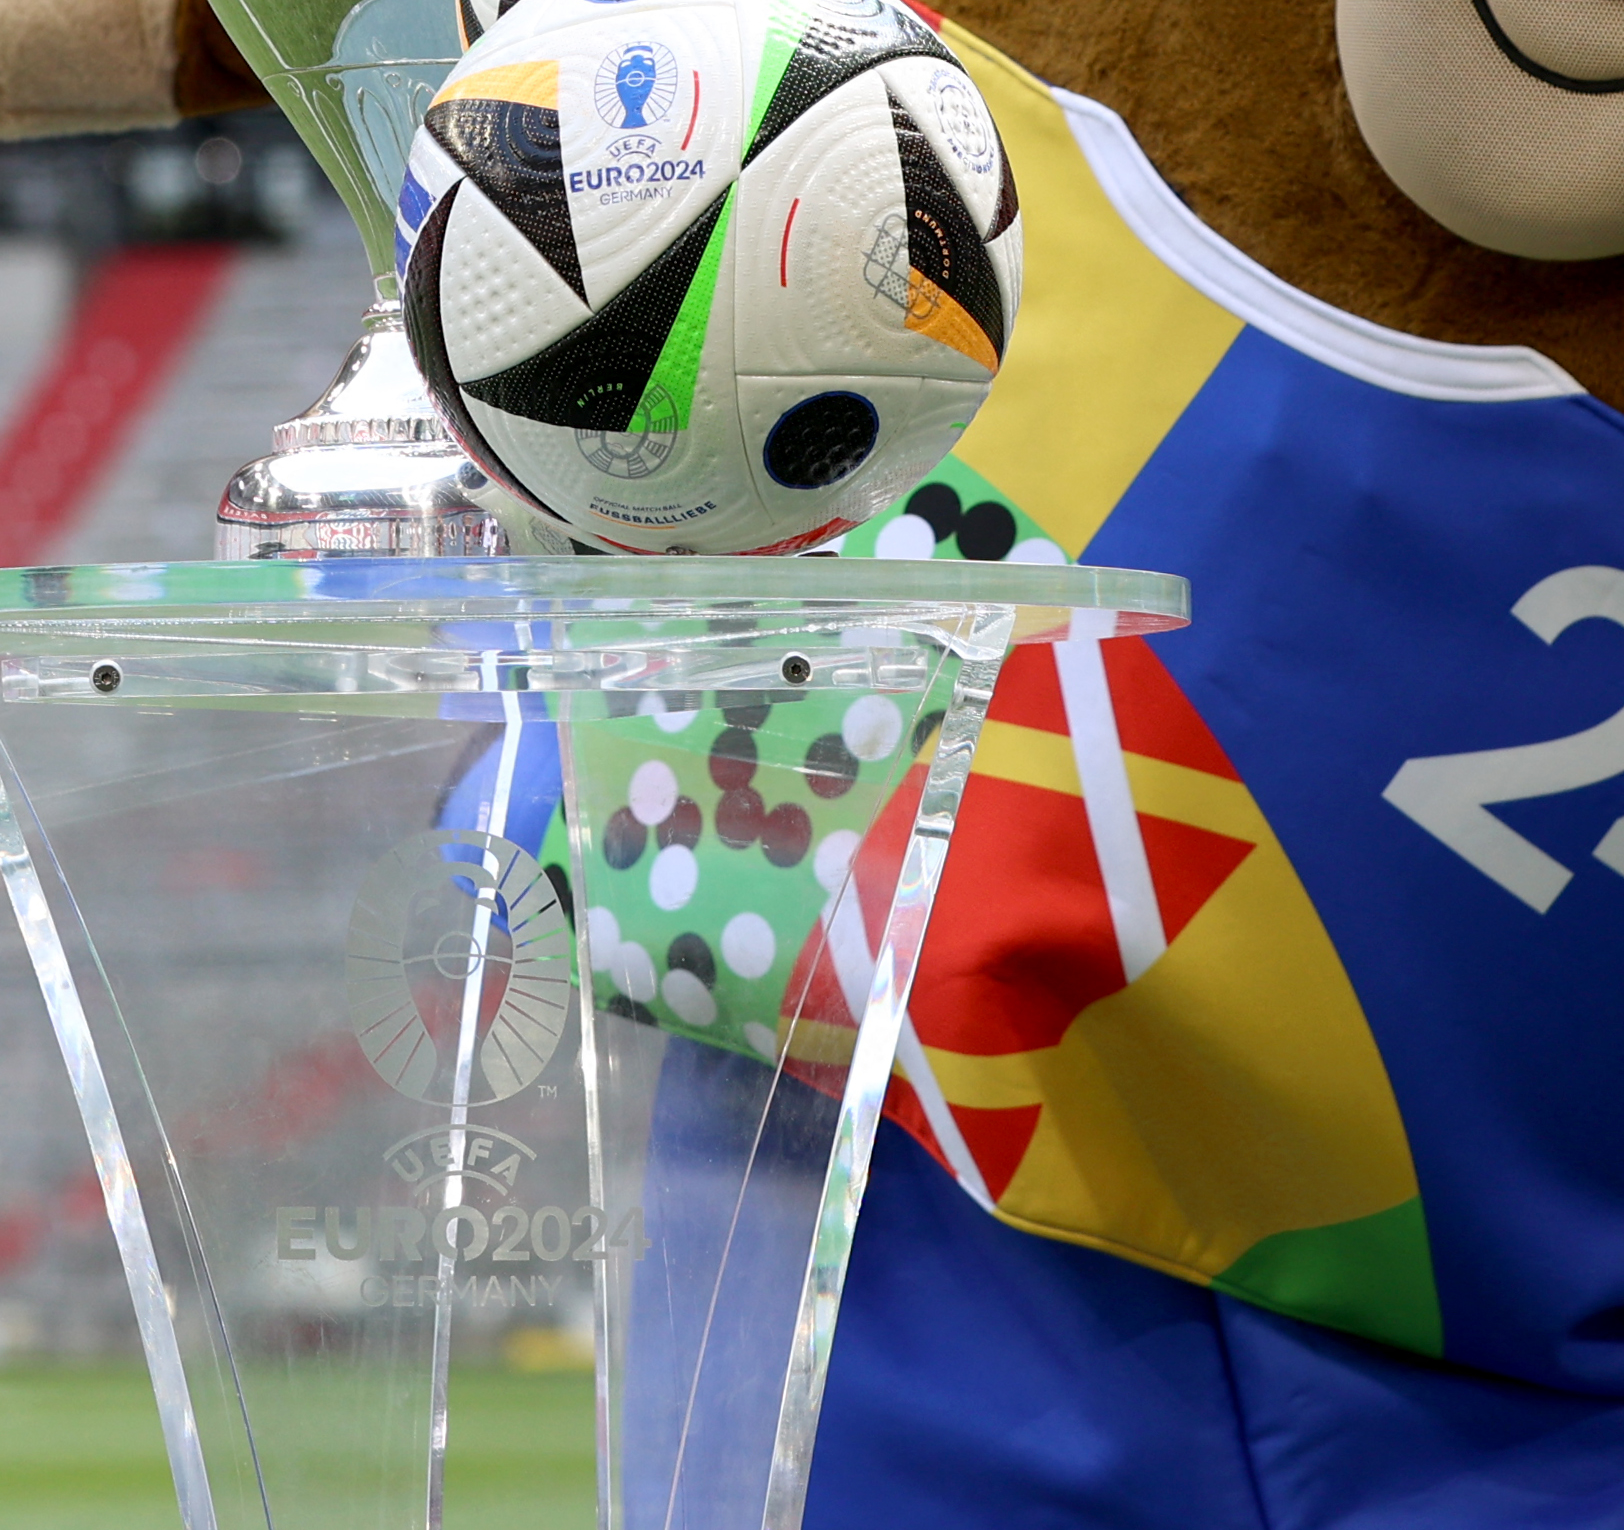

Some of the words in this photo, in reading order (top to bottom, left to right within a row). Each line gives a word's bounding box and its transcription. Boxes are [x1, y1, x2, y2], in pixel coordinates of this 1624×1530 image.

[609, 138, 657, 159] UEFA
[569, 159, 706, 193] EURO2024
[599, 186, 674, 206] GERMANY
[914, 210, 951, 280] DORTMUND
[576, 382, 624, 409] BERLIN
[589, 500, 718, 525] FUSSBALLLIEBE
[592, 496, 630, 511] OFFICIAL
[662, 503, 683, 512] BALL
[391, 1136, 522, 1187] UEFA
[276, 1205, 653, 1262] EURO2024
[359, 1275, 564, 1308] GERMANY
